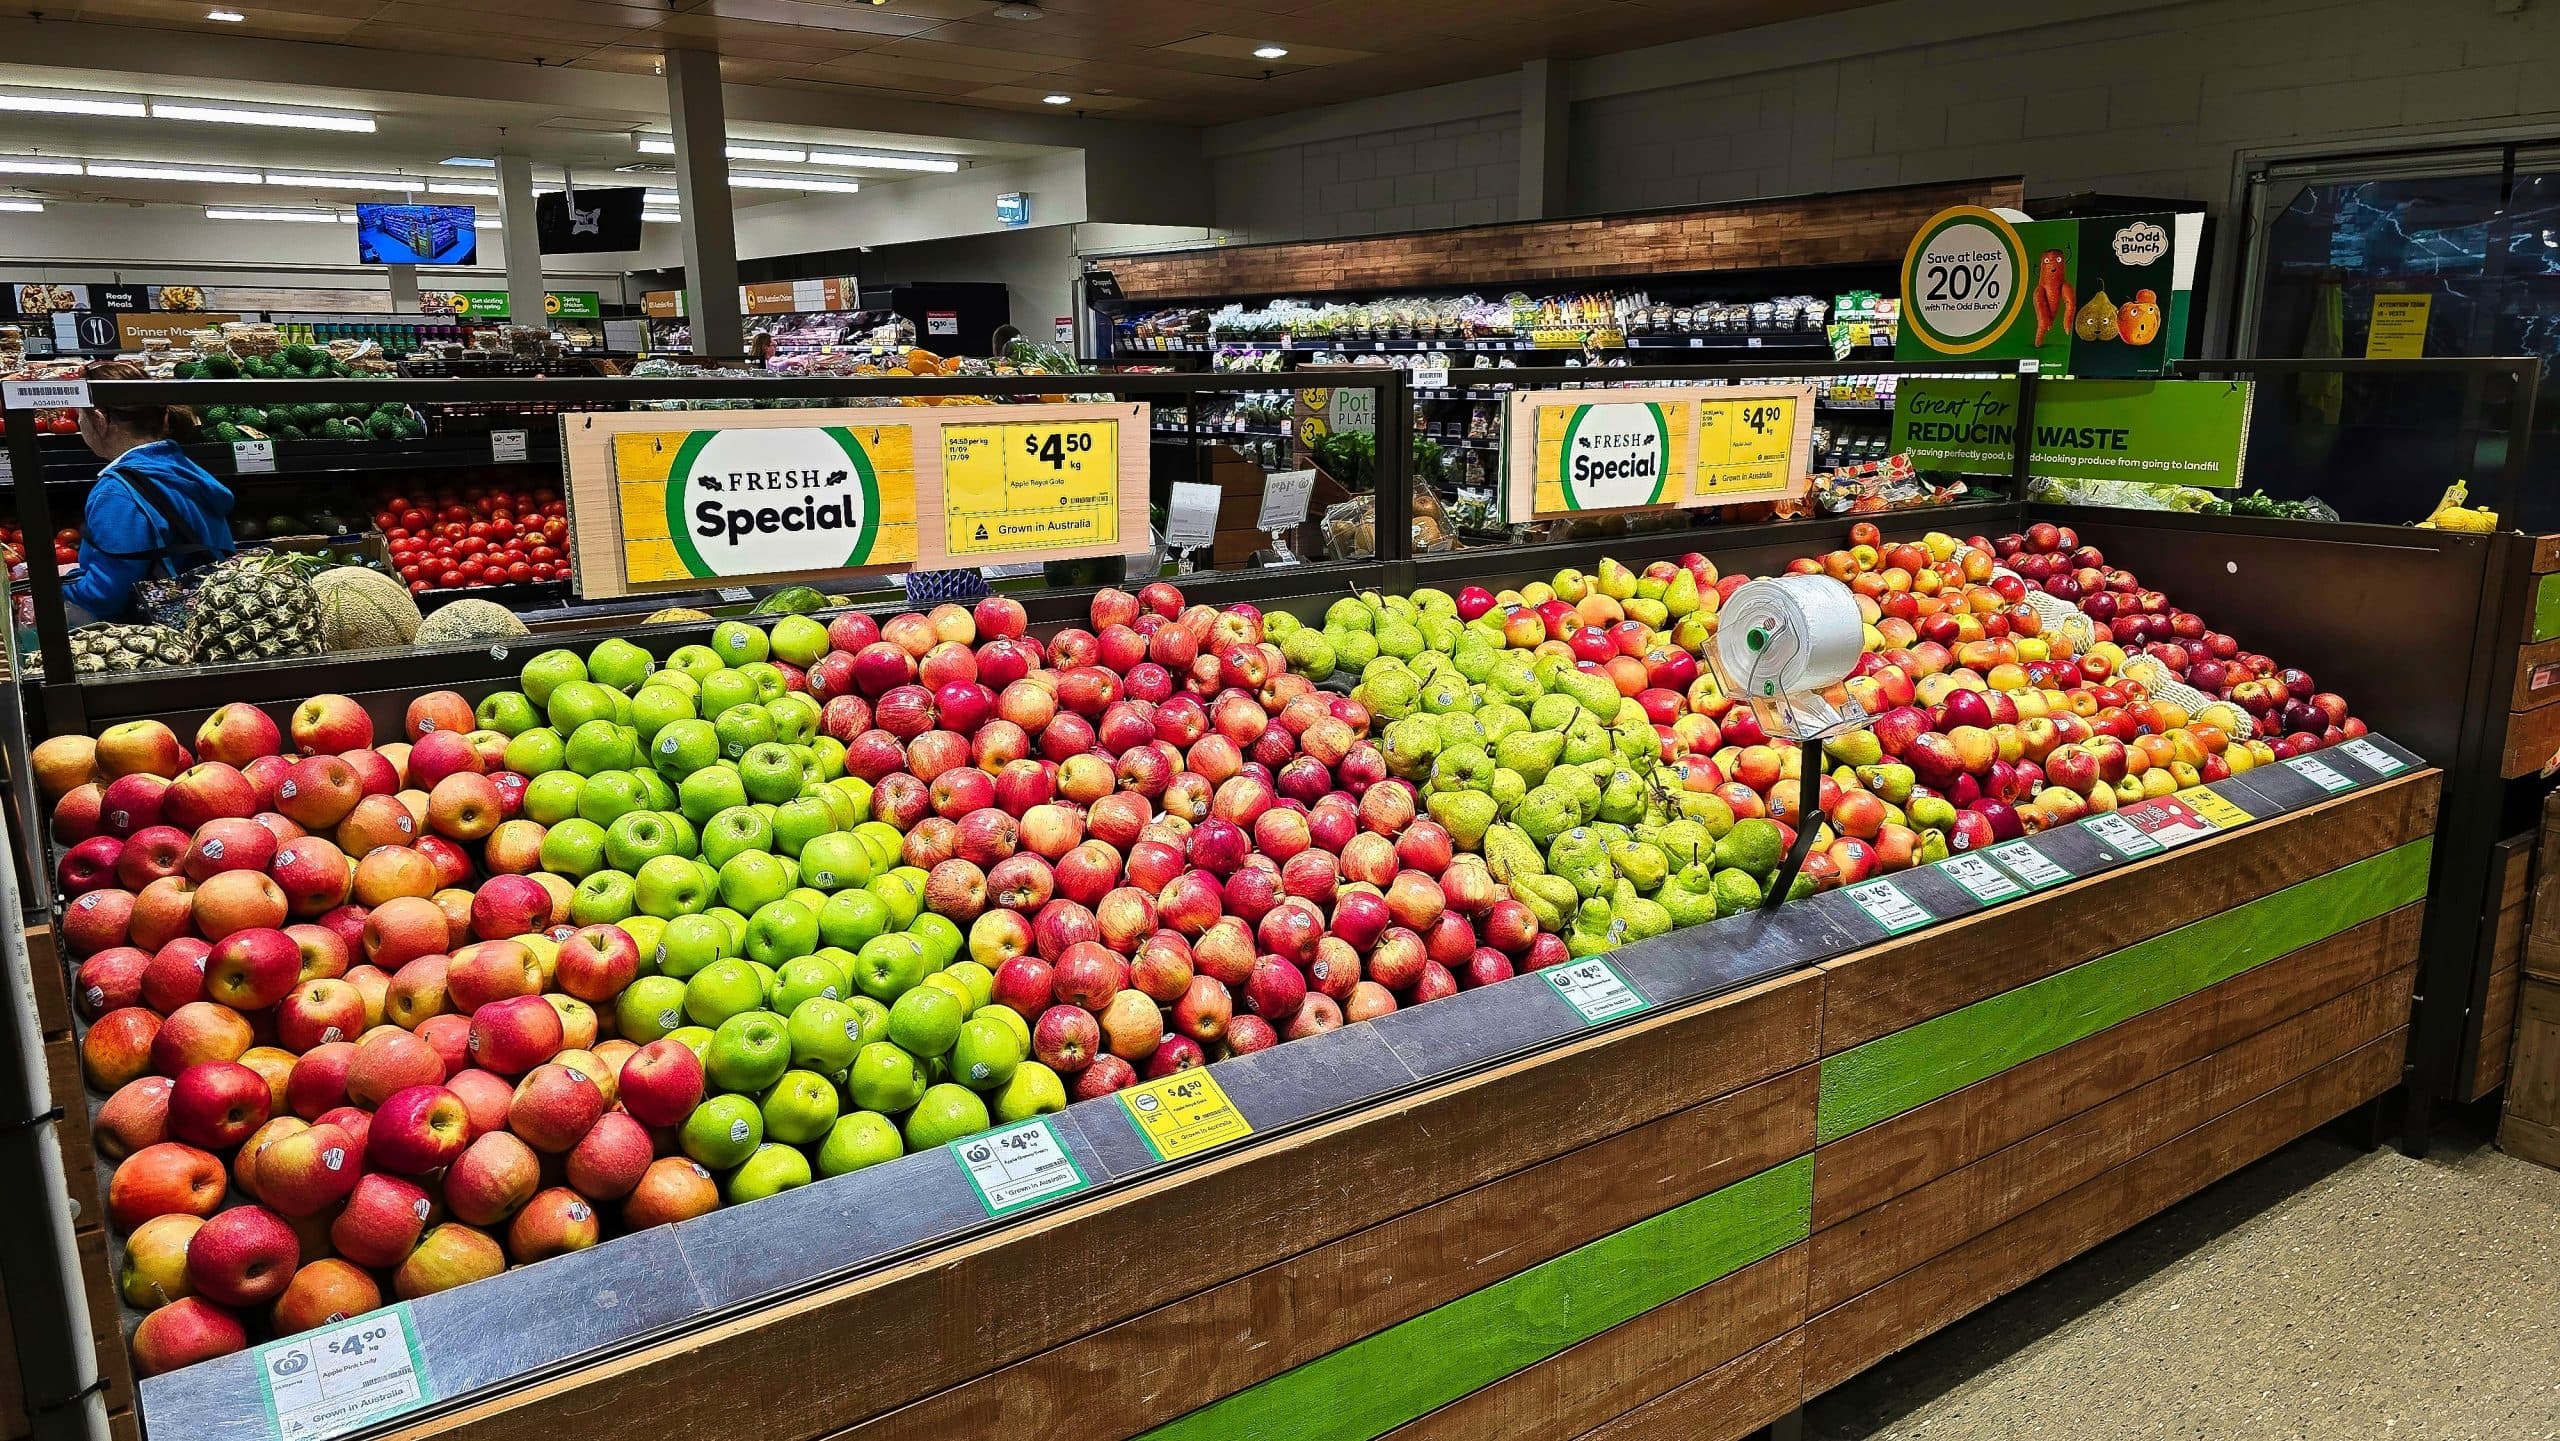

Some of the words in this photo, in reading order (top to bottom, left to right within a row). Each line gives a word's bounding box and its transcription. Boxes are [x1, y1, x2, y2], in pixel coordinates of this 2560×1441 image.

[2135, 232, 2160, 242] Odd
[2121, 243, 2160, 253] Bunch
[1927, 253, 1955, 264] Save
[1957, 252, 1971, 262] at
[1972, 250, 2002, 262] least
[1926, 264, 2000, 301] 20%
[105, 292, 133, 301] Ready
[107, 301, 133, 309] Meals
[1924, 303, 1941, 312] with
[1942, 303, 1956, 311] The
[1956, 302, 1973, 311] Odd
[126, 327, 169, 337] Dinner
[1339, 391, 1368, 412] Pot
[1909, 391, 1971, 419] Great
[1971, 391, 2011, 425] for
[1766, 428, 1773, 436] kg
[2036, 426, 2130, 451] WASTE
[949, 438, 968, 446] $4.50
[968, 438, 979, 447] per
[979, 438, 989, 446] kg
[1594, 433, 1642, 449] FRESH
[1070, 460, 1081, 471] kg
[1905, 446, 1917, 456] By
[1917, 449, 1944, 459] saving
[1944, 449, 1980, 461] perfectly
[1981, 451, 2006, 462] good,
[2029, 453, 2077, 466] dd-looking
[2077, 455, 2116, 467] produce
[2118, 456, 2140, 467] from
[2142, 459, 2170, 471] going
[2171, 460, 2182, 469] to
[2184, 460, 2219, 472] landfill
[1574, 451, 1656, 488] Special
[1722, 474, 1741, 482] Grown
[1748, 471, 1773, 480] Australia
[728, 470, 820, 492] FRESH
[1010, 480, 1030, 488] Apple
[696, 494, 857, 546] Special
[998, 523, 1033, 535] Grown
[1035, 521, 1045, 532] in
[1048, 518, 1091, 531] Australia
[1180, 1130, 1200, 1140] Grown
[1200, 1126, 1208, 1134] in
[1207, 1119, 1233, 1132] Australia
[1008, 1184, 1031, 1196] Grown
[1039, 1173, 1067, 1187] Australia
[369, 1344, 379, 1352] kg
[322, 1367, 343, 1378] Apple
[343, 1362, 359, 1372] Pink
[359, 1357, 377, 1369] Lady
[312, 1407, 346, 1423] Grown
[348, 1401, 359, 1412] in
[360, 1387, 404, 1409] Australia
